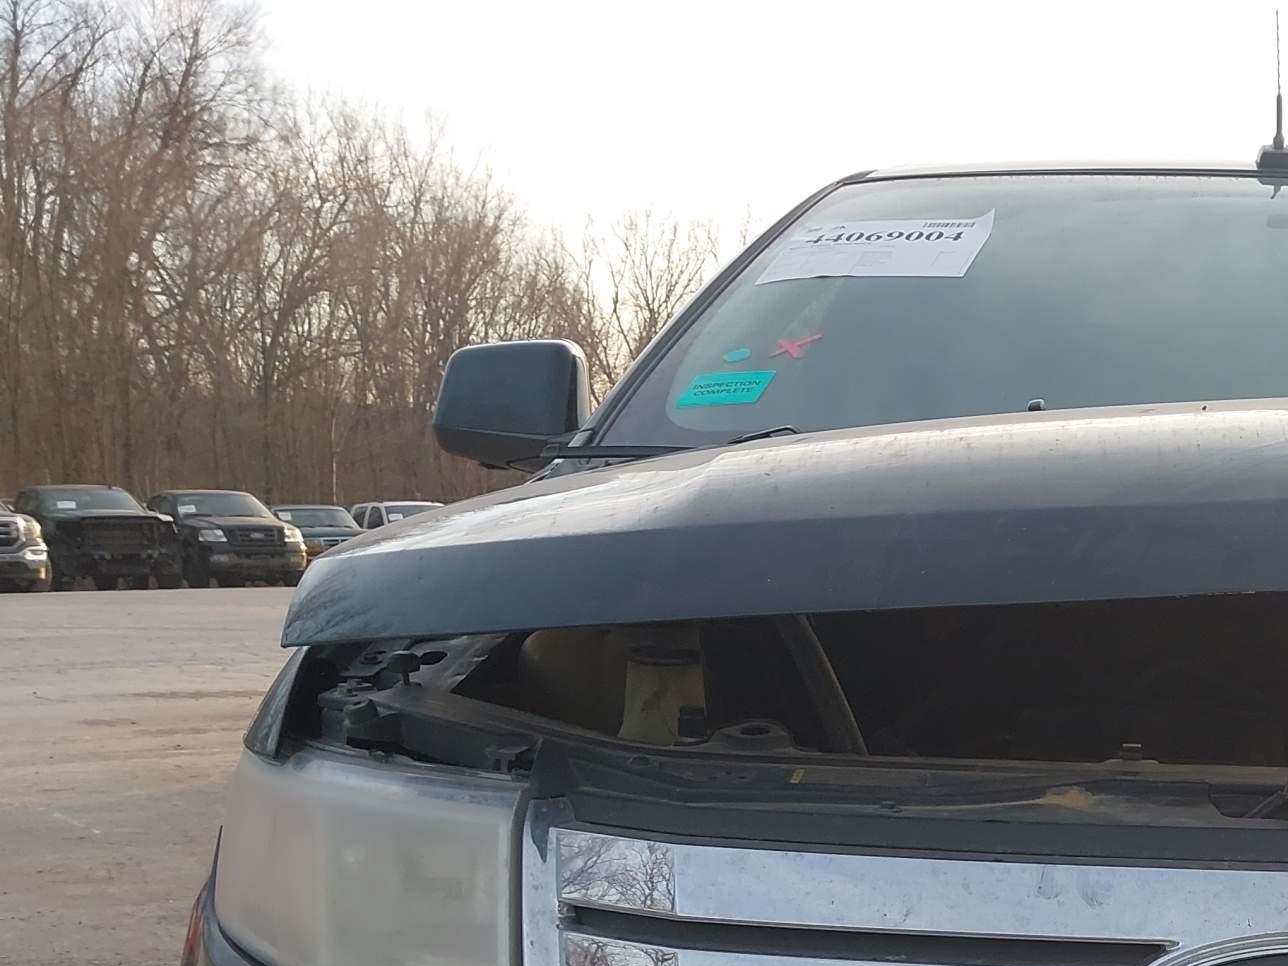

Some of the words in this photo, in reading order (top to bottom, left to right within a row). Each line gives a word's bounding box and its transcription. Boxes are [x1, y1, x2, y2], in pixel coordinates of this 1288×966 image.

[805, 230, 964, 244] 44069004
[692, 380, 761, 390] INSPECTION
[693, 386, 754, 397] COMPLETE
